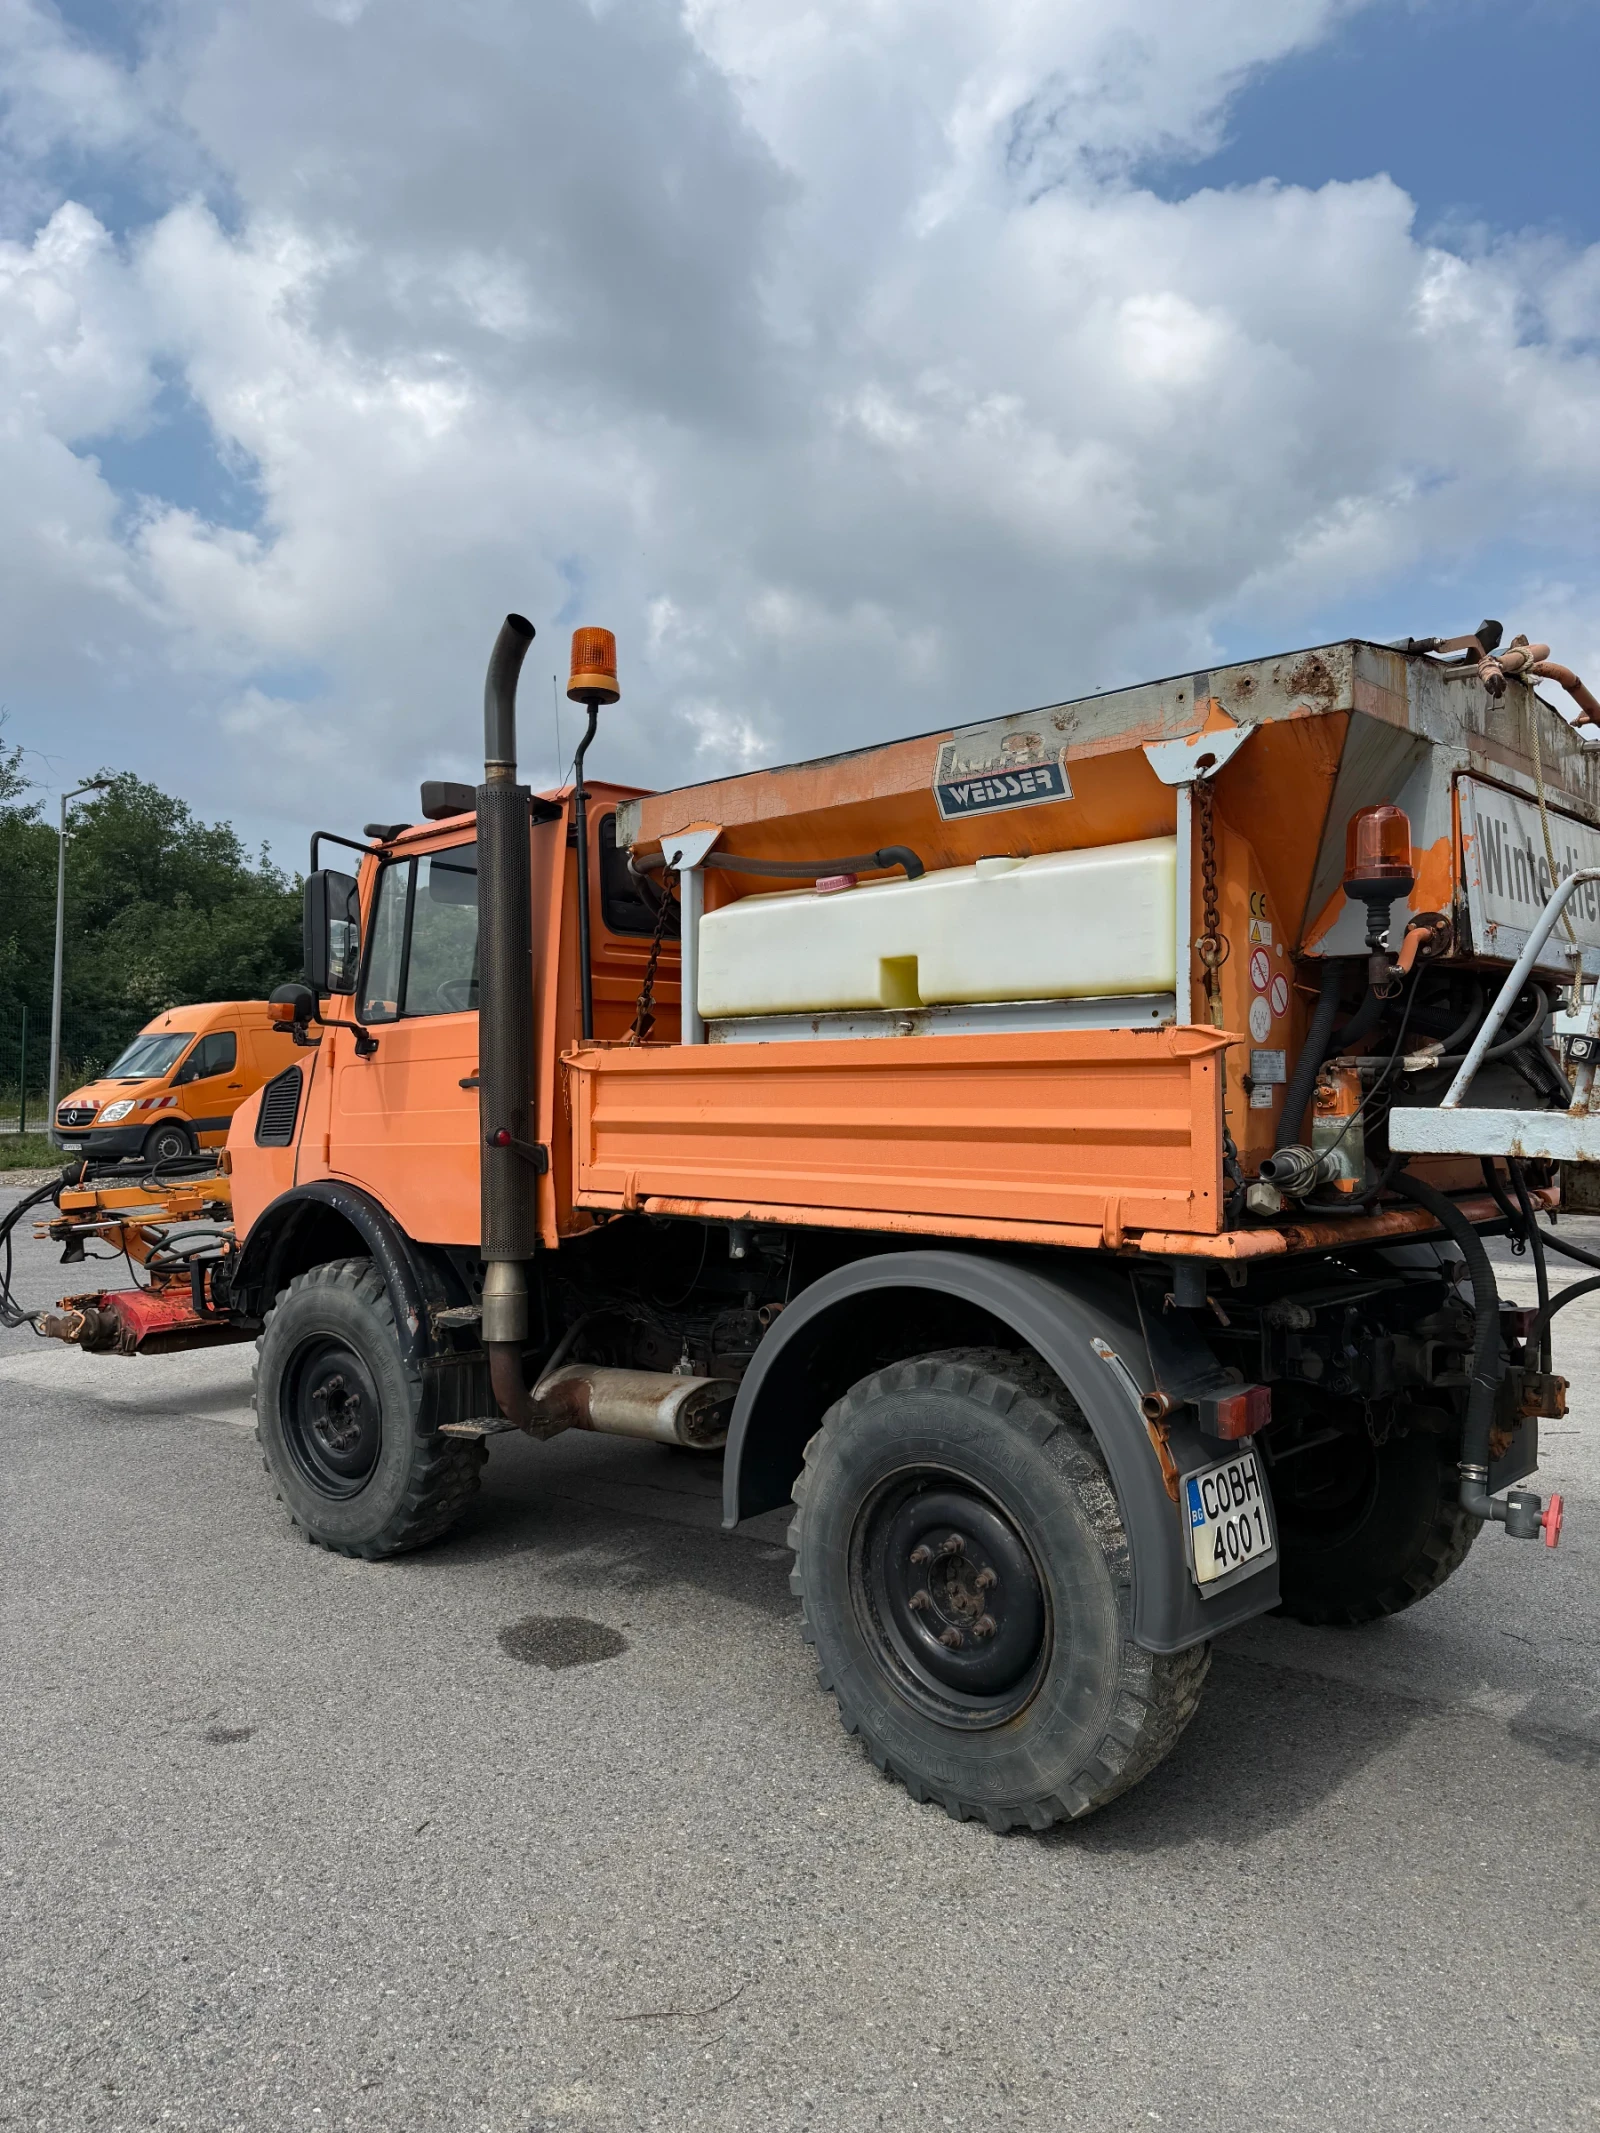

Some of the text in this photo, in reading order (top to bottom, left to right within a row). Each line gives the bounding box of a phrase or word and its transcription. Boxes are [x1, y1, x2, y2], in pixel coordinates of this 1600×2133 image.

[949, 769, 1053, 808] WEISSER
[1477, 812, 1600, 922] Wintedie
[1192, 1508, 1204, 1523] BG
[1201, 1458, 1260, 1520] COBH
[1213, 1506, 1266, 1567] 4001
